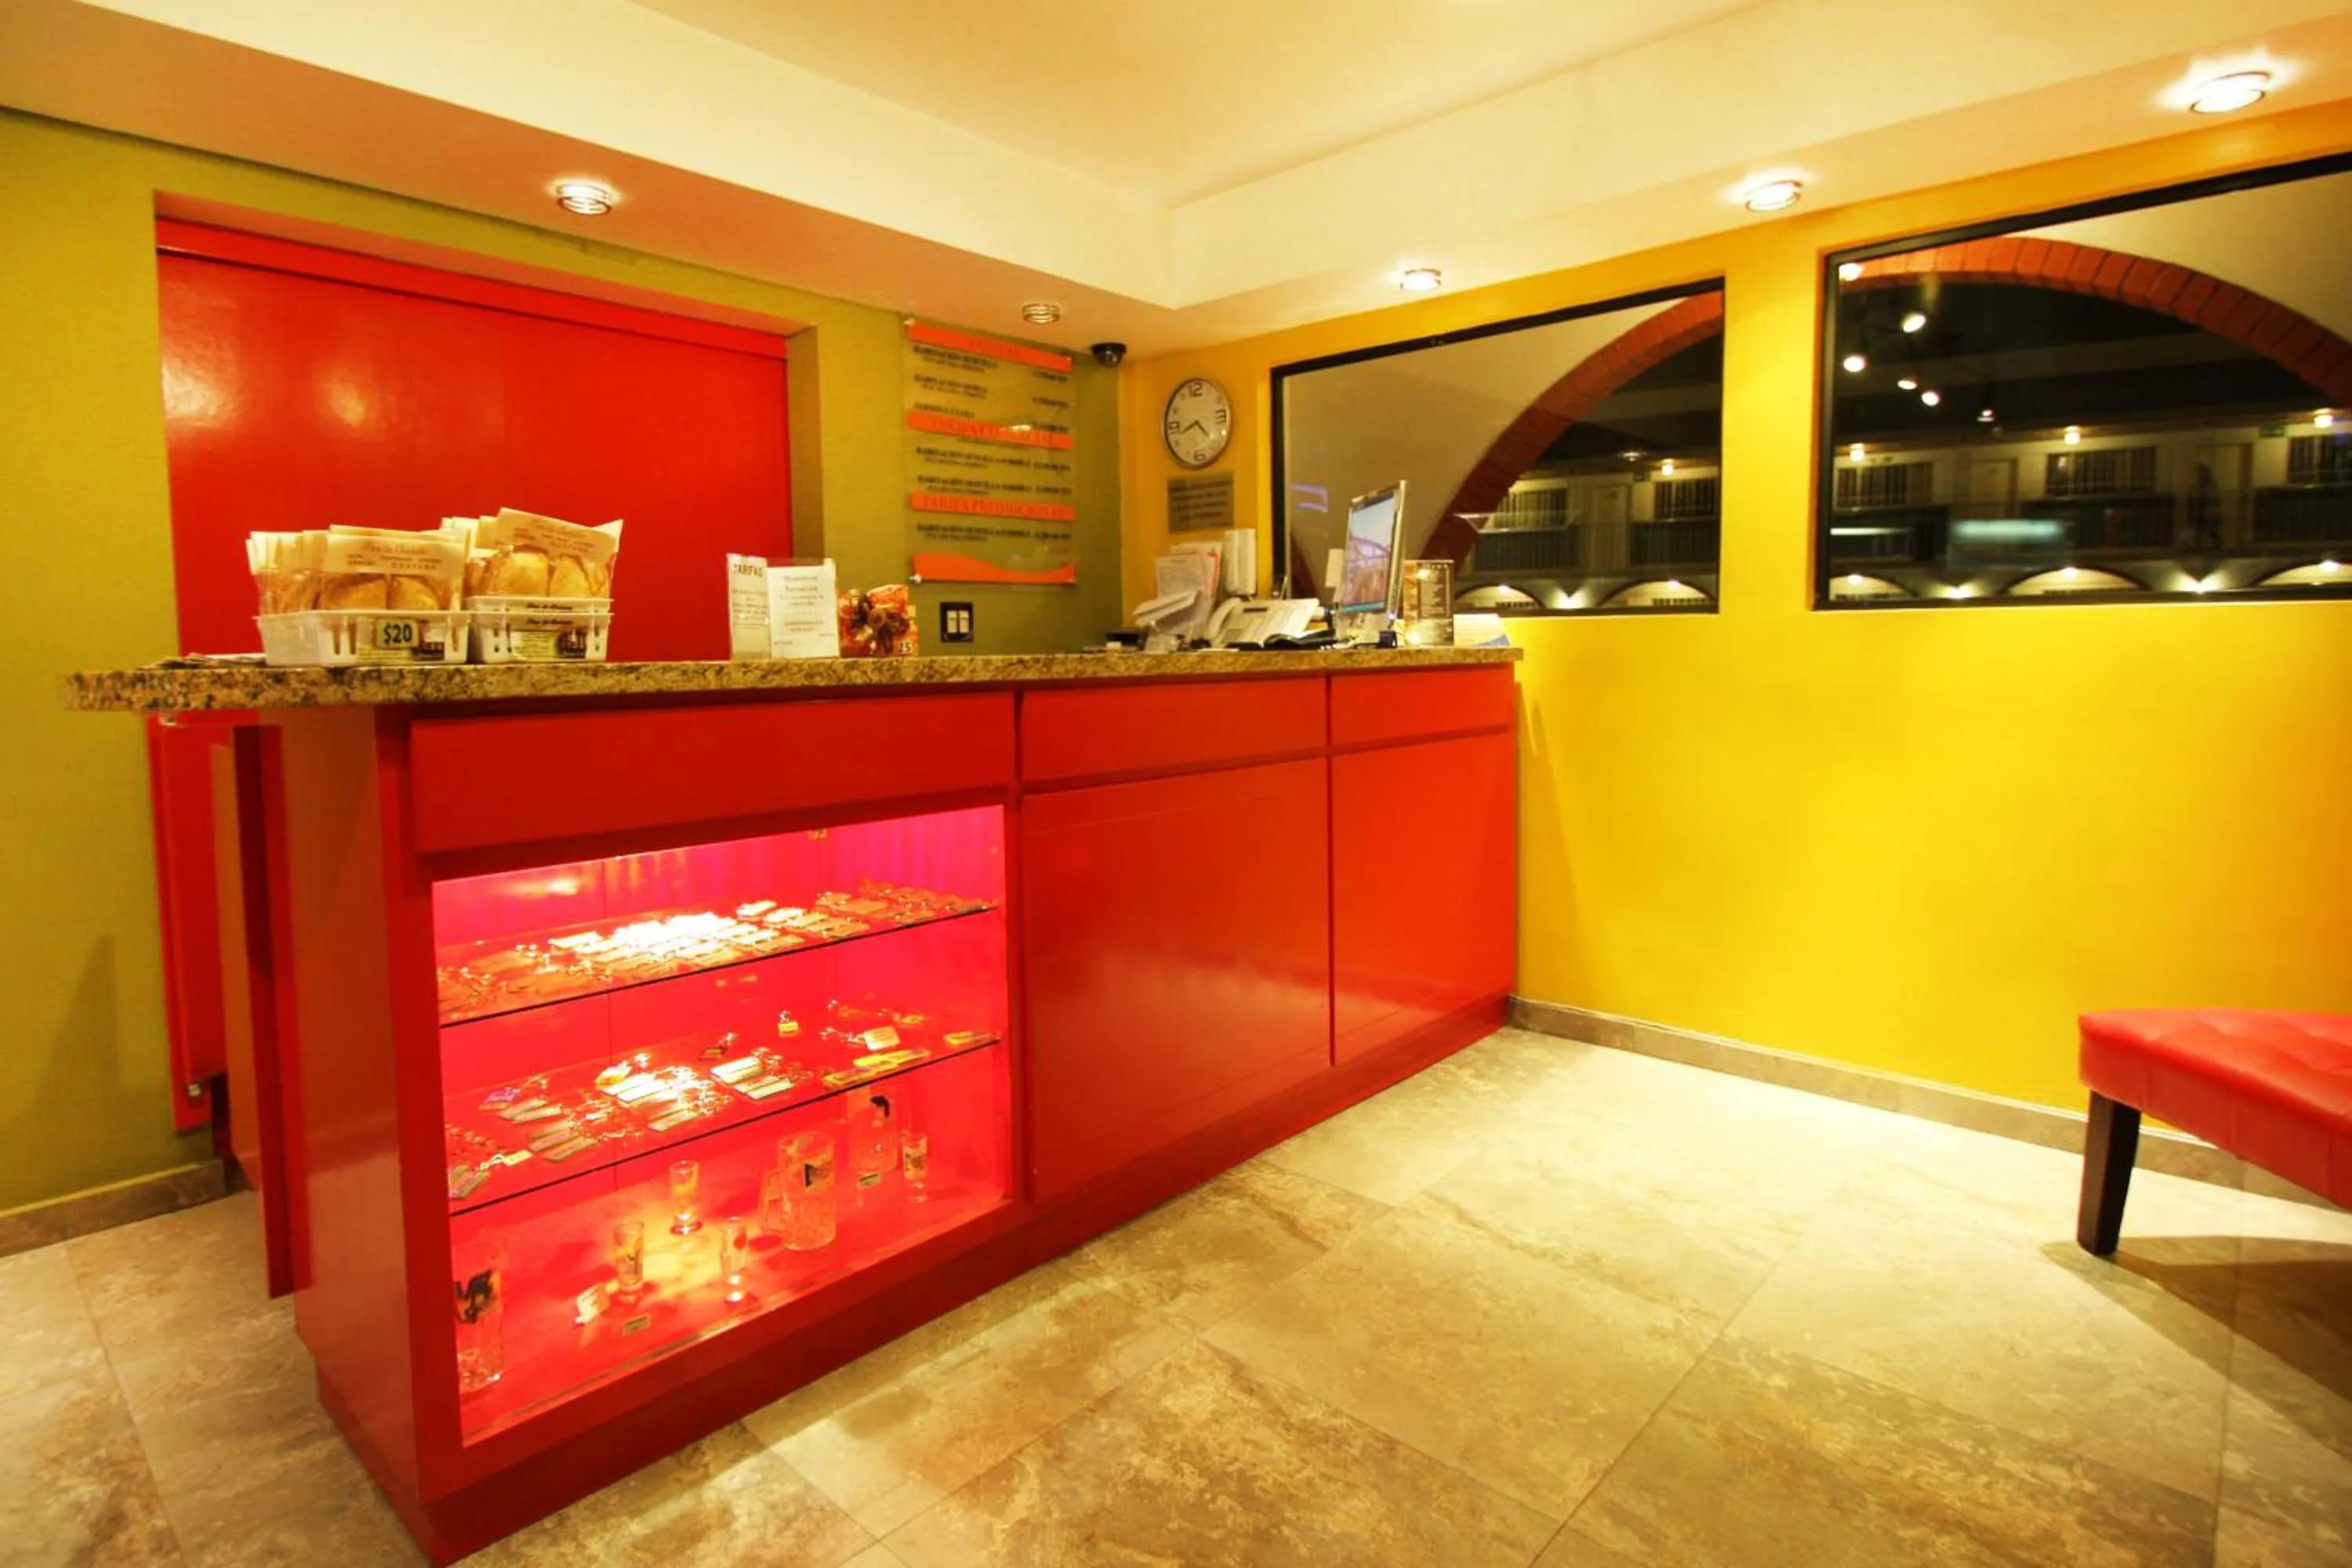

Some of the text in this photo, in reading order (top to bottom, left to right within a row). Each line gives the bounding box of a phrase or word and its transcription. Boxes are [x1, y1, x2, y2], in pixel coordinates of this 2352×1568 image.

[1189, 382, 1203, 397] 12
[1215, 408, 1227, 424] 3
[1168, 421, 1180, 435] 9
[383, 622, 412, 646] $20
